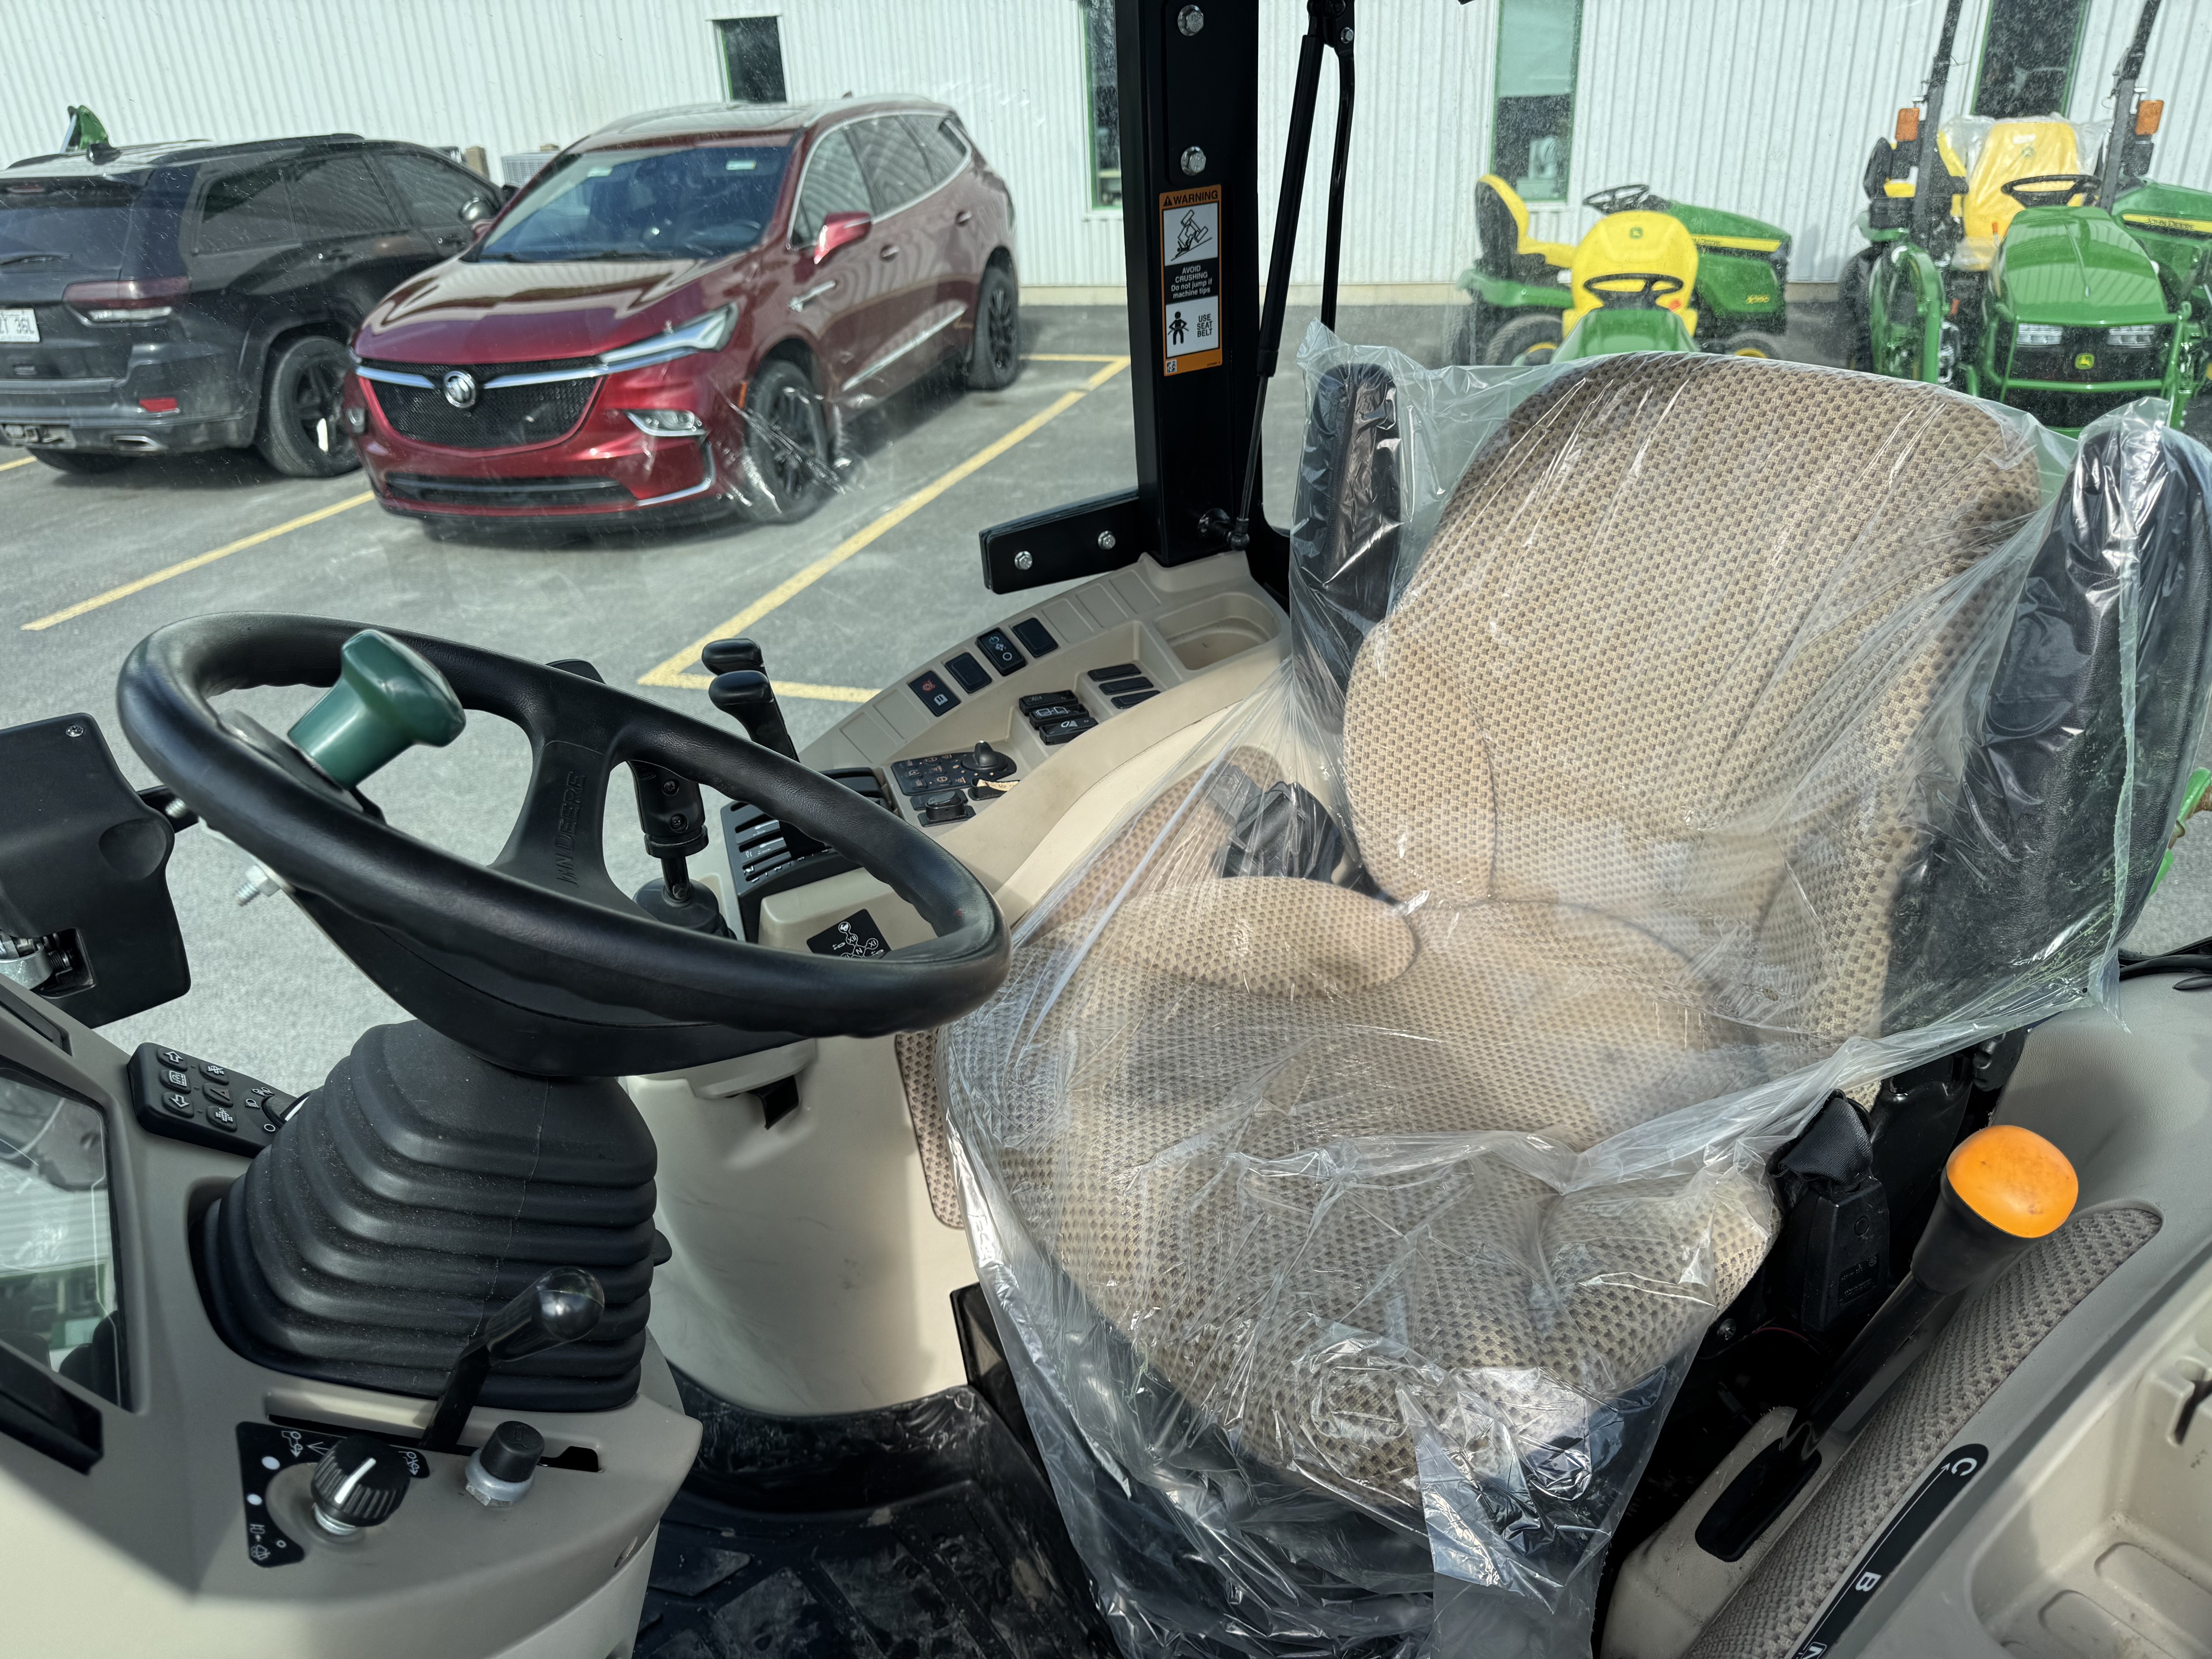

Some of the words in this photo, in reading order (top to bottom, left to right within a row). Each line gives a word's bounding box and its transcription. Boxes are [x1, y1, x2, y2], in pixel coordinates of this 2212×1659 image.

[1173, 190, 1218, 205] WARNING
[2145, 218, 2167, 227] JOHN
[2169, 222, 2195, 230] DEERE
[1182, 265, 1201, 275] AVOID
[1175, 272, 1208, 283] CRUSHING
[1192, 280, 1207, 289] jump
[1173, 289, 1198, 299] machine
[1199, 287, 1211, 296] tips
[1199, 314, 1211, 322] USE
[1197, 321, 1213, 330] SEAT
[1197, 328, 1212, 337] BELT
[555, 771, 586, 853] DEERE
[556, 854, 579, 888] JOHN
[848, 935, 857, 943] XII
[1951, 1457, 1977, 1477] C
[1855, 1571, 1882, 1592] B
